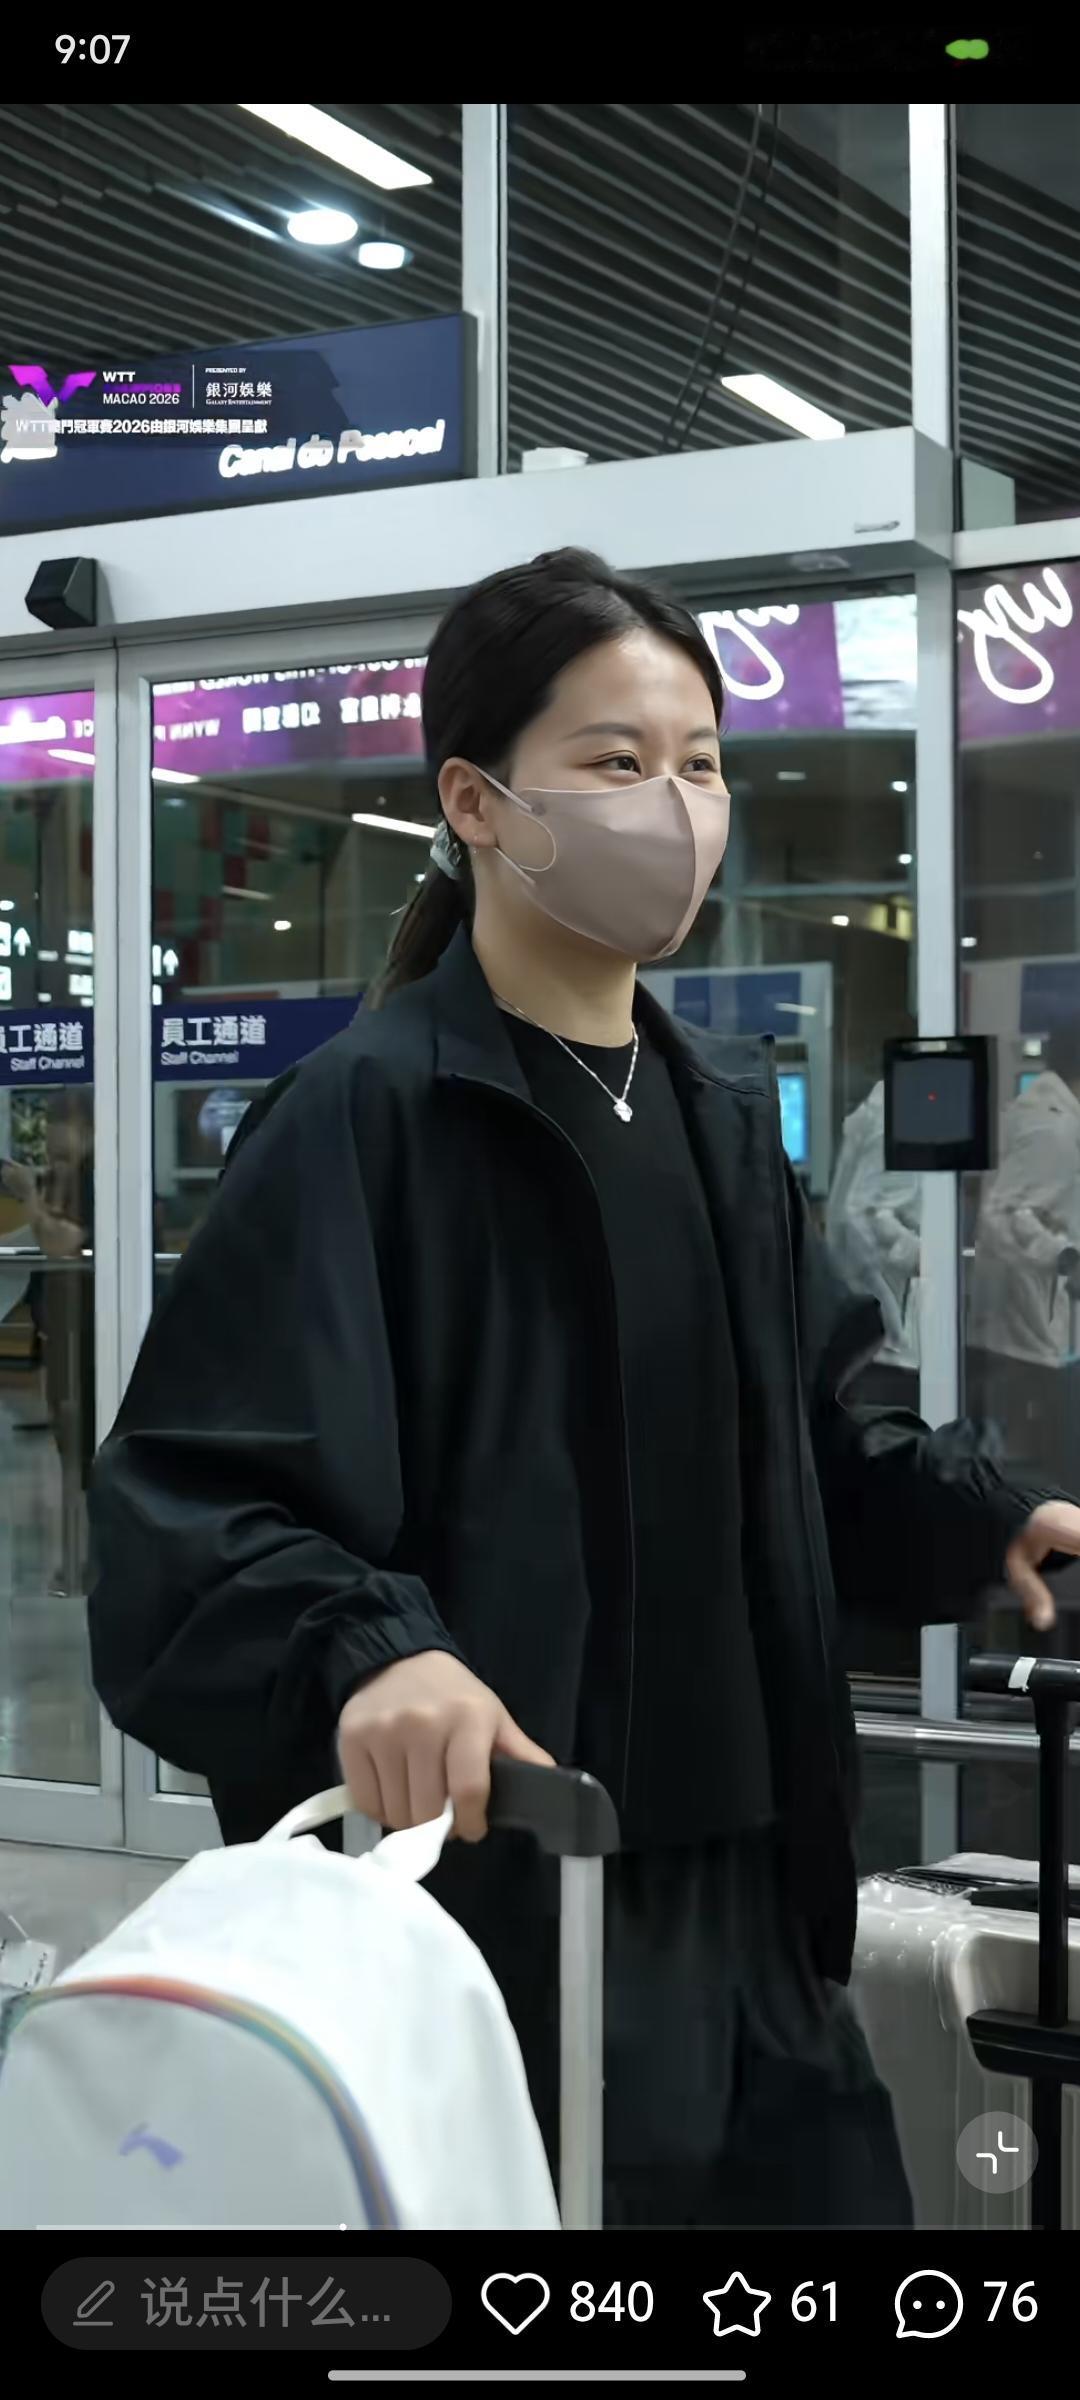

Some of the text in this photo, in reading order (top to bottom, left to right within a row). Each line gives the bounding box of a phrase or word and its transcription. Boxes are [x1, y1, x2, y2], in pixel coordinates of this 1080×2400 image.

[160, 1014, 266, 1047] 員工通道
[160, 1050, 239, 1065] Staff Channel
